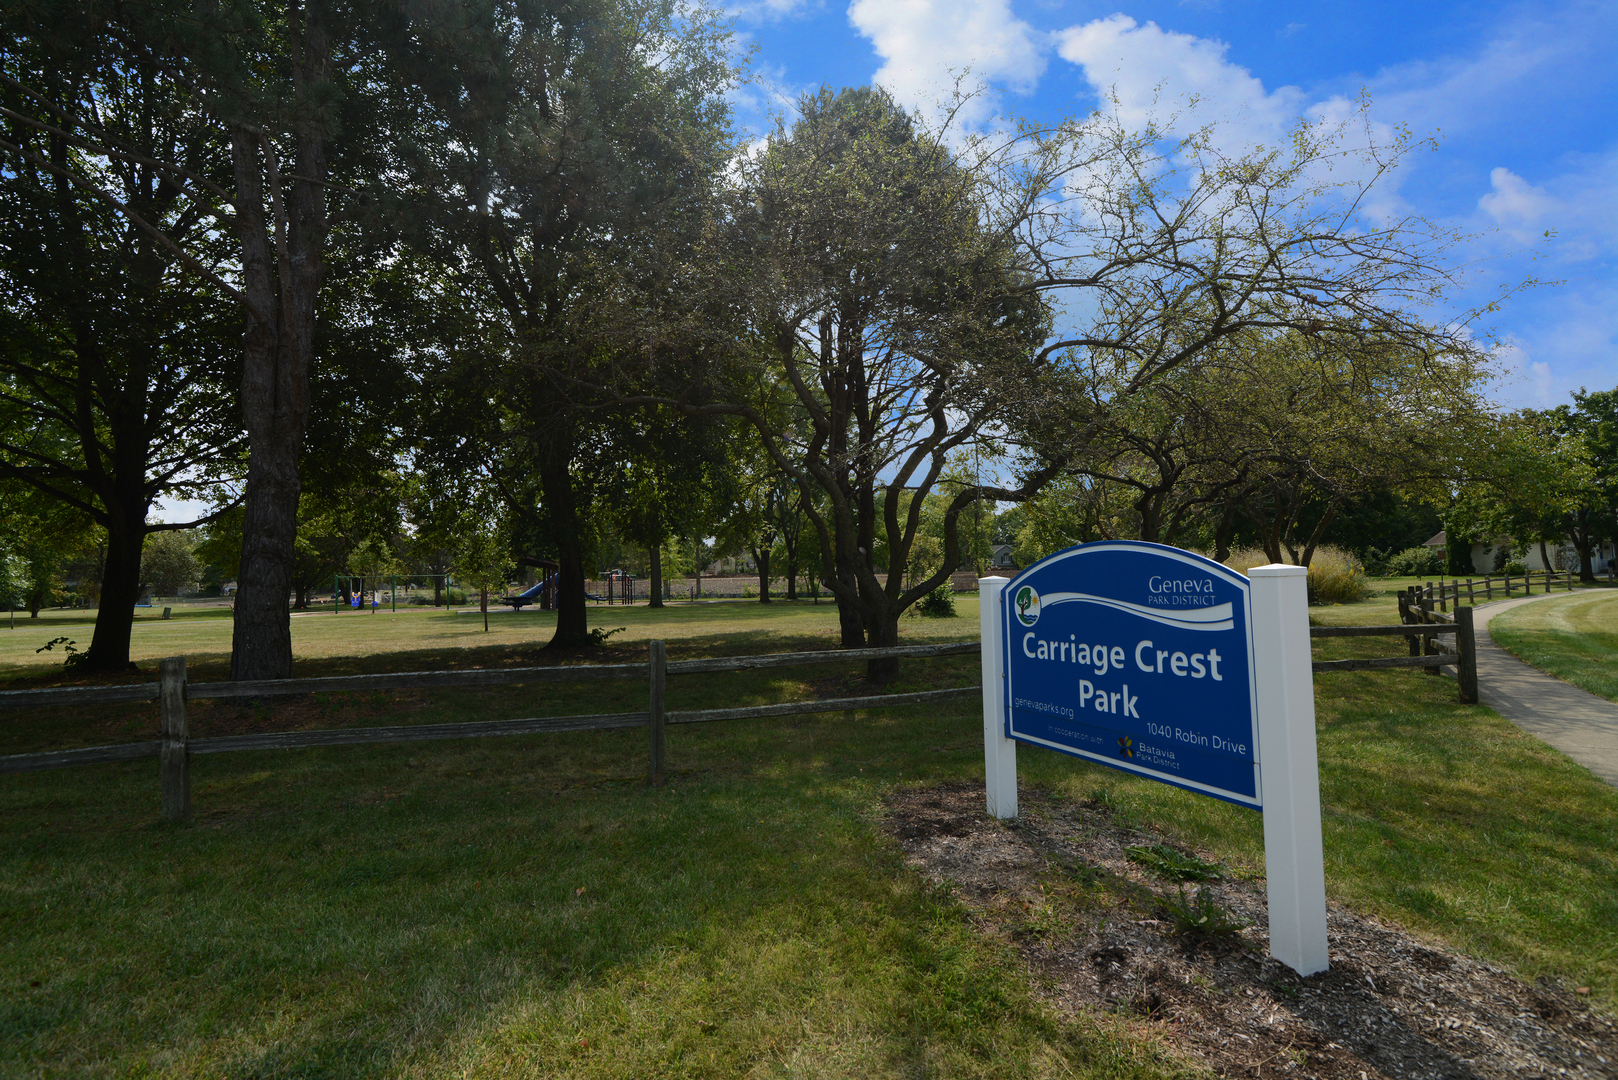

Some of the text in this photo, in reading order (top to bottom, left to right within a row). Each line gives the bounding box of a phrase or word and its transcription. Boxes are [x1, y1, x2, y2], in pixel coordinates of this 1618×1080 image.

[1149, 576, 1213, 593] Geneva
[1148, 595, 1216, 605] PARK DISTRICT
[1023, 632, 1223, 681] Carriage Crest
[1015, 698, 1074, 719] genevaparks.org
[1079, 679, 1140, 719] Park
[1147, 723, 1246, 755] 1040 Robin Drive
[1137, 751, 1180, 770] Park District
[1139, 742, 1175, 759] Batavia
